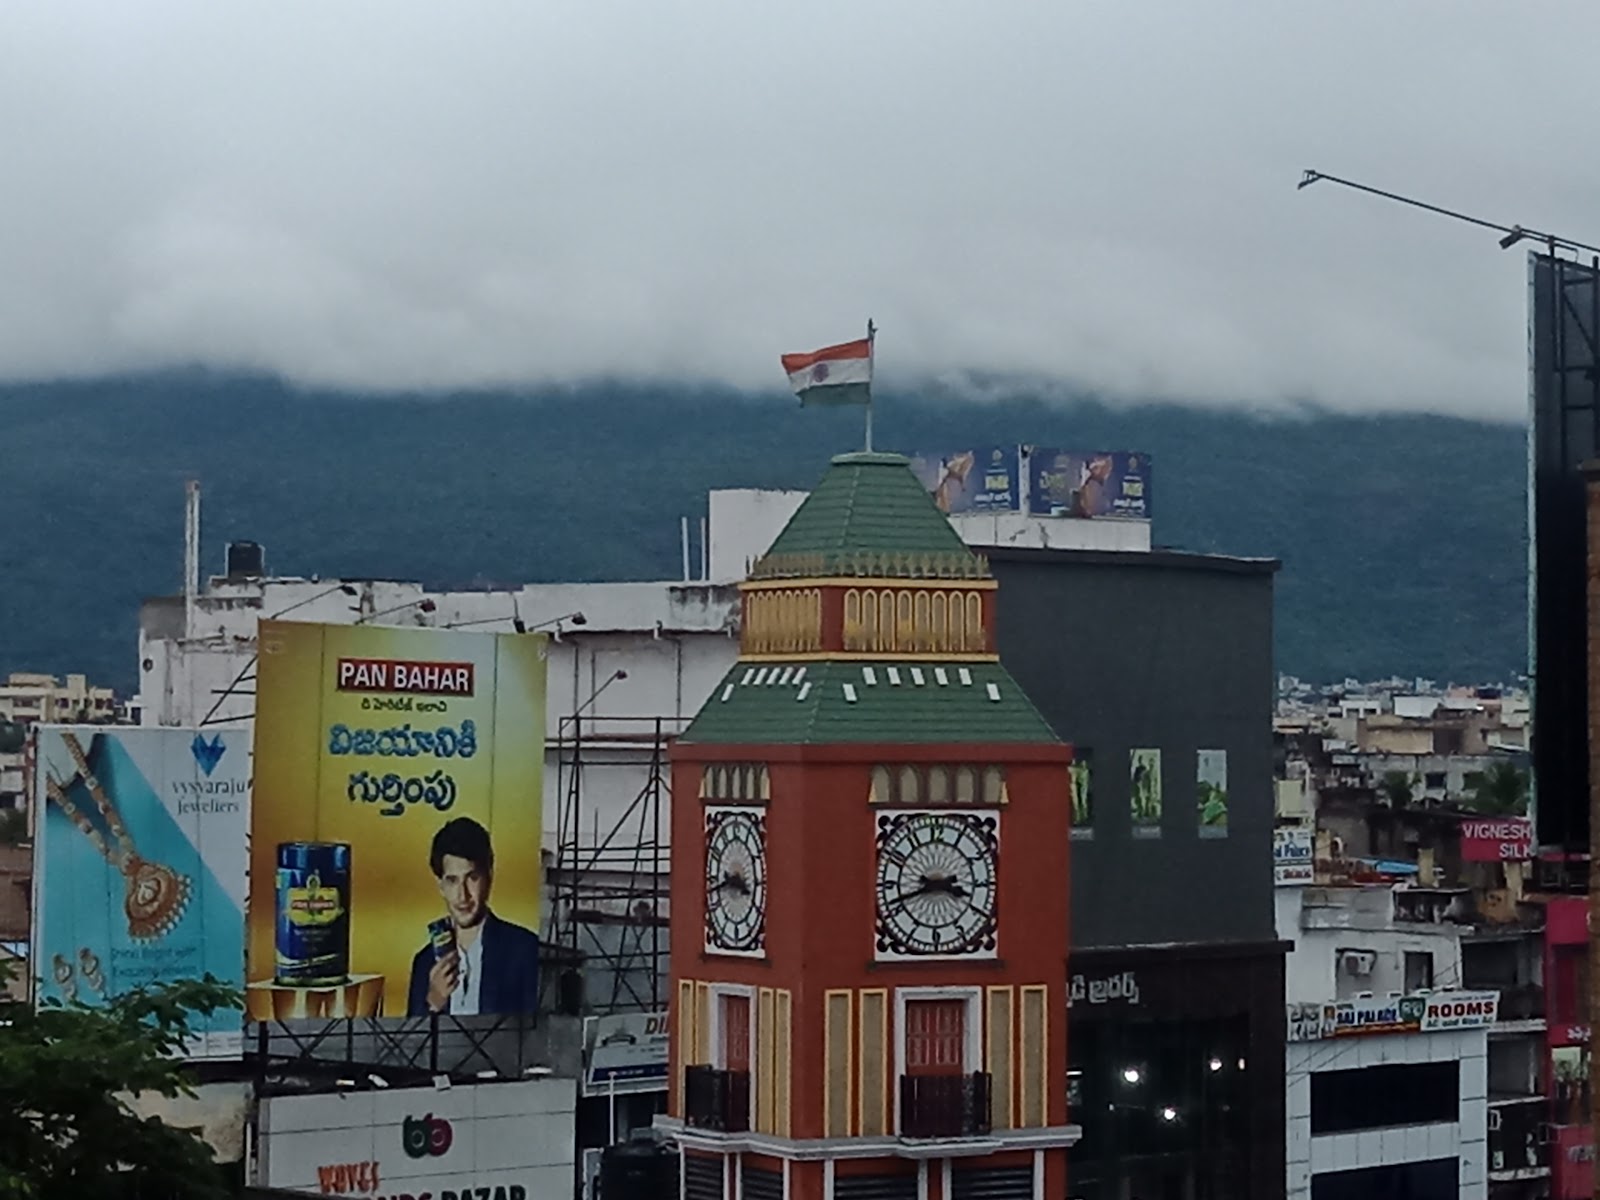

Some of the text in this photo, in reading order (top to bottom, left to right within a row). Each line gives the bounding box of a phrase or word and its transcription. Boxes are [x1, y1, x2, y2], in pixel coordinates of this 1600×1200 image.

[341, 662, 469, 691] PAN BAHAR
[329, 719, 477, 758] విజయానికి
[348, 769, 456, 816] గుర్తింపు
[1462, 823, 1530, 839] VIGNESH
[1428, 1001, 1494, 1018] ROOMS
